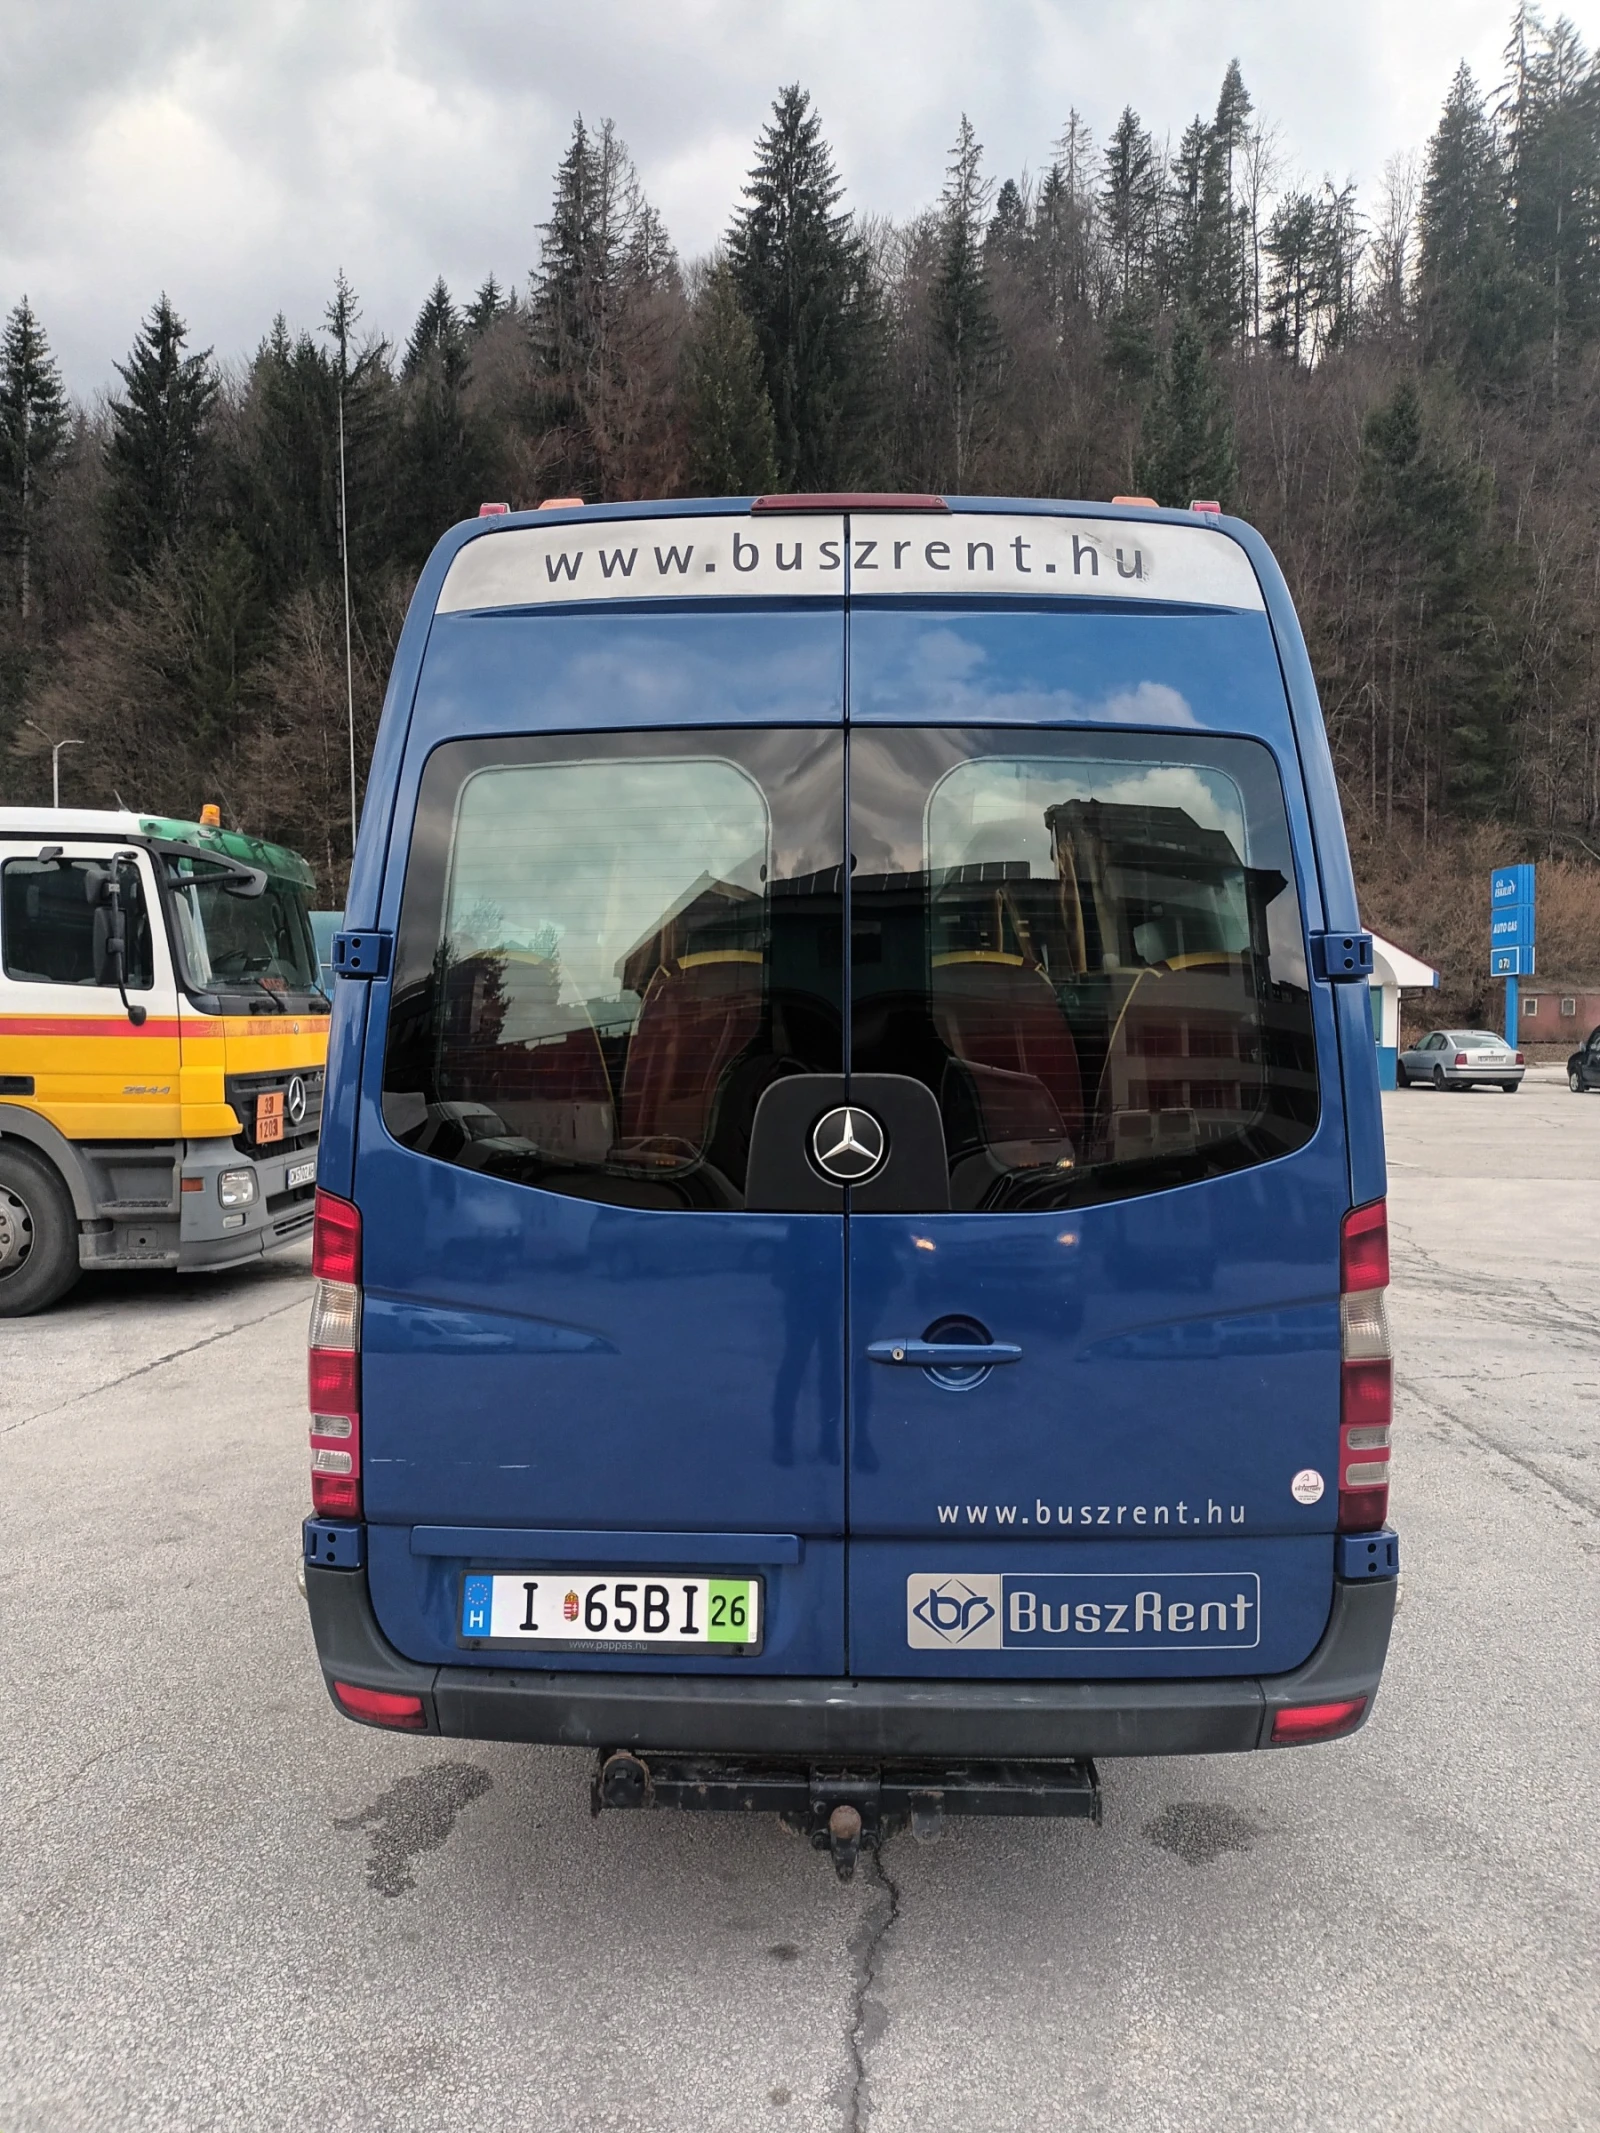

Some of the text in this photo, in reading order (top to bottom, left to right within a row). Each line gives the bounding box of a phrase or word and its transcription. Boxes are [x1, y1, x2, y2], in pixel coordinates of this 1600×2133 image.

[545, 532, 1142, 583] www.buszrent.hu
[1493, 920, 1518, 934] AUTO GAS
[259, 1118, 278, 1138] 1203
[937, 1499, 1246, 1525] www.buszrent.hu
[468, 1610, 484, 1628] H
[584, 1583, 699, 1634] 65BI
[711, 1595, 746, 1627] 26
[1009, 1591, 1254, 1633] BuszRent
[568, 1641, 648, 1652] www.pappas.hu
